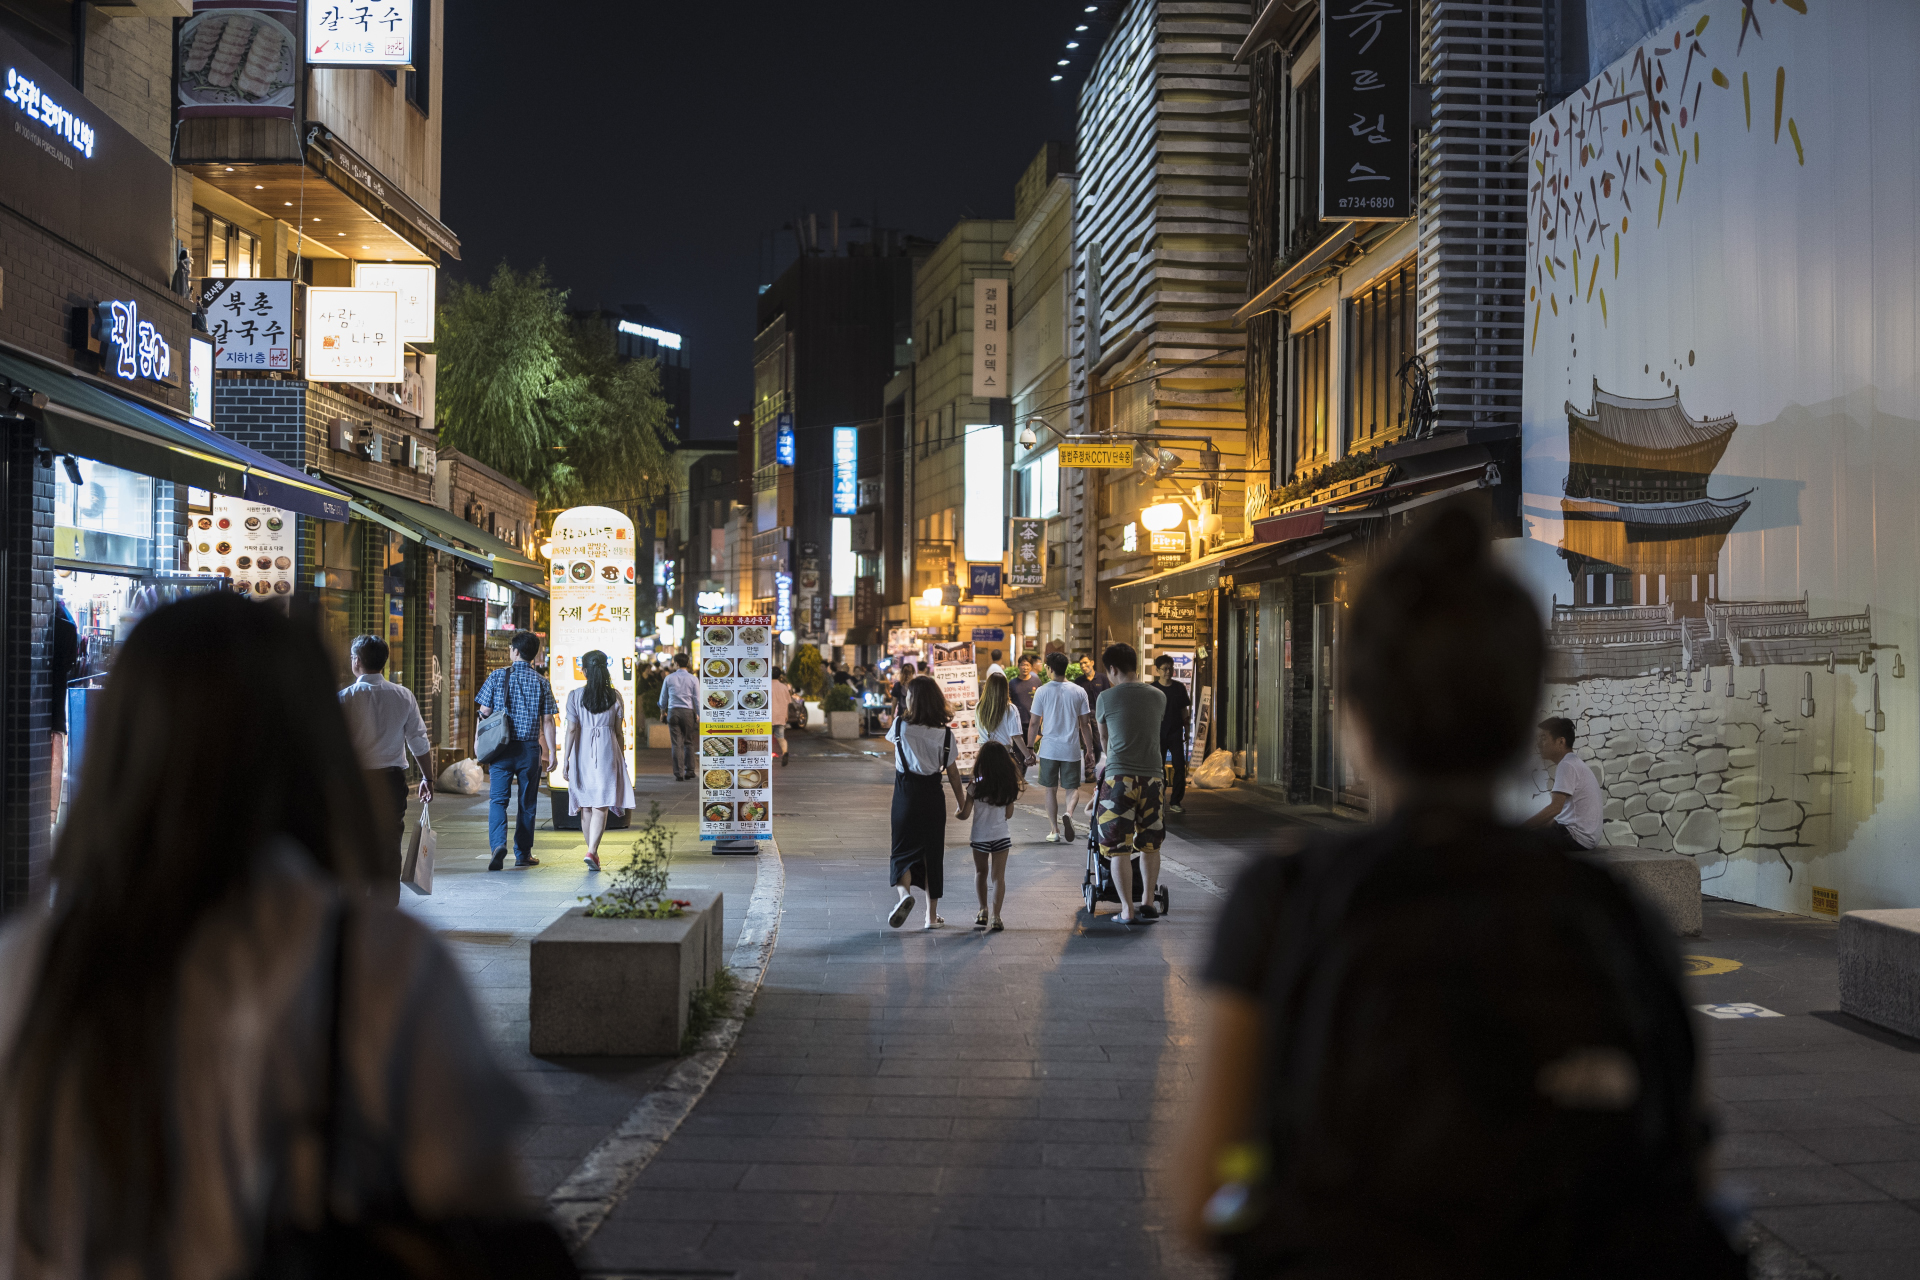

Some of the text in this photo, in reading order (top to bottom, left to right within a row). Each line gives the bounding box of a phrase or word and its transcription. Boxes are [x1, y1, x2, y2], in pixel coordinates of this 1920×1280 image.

[319, 6, 402, 32] 칼국수
[334, 42, 374, 53] 지하1층
[41, 93, 72, 143] 도자기
[72, 116, 94, 158] 인형
[1348, 198, 1394, 208] 734-6890
[204, 281, 225, 301] 인사동
[223, 291, 273, 316] 북촌
[211, 319, 284, 346] 칼국수
[352, 332, 387, 346] 나무
[984, 288, 996, 386] 갤러리 인덱스
[226, 352, 266, 364] 지하1층
[1015, 564, 1041, 573] 다암
[558, 603, 630, 622] 수제 生 맥주
